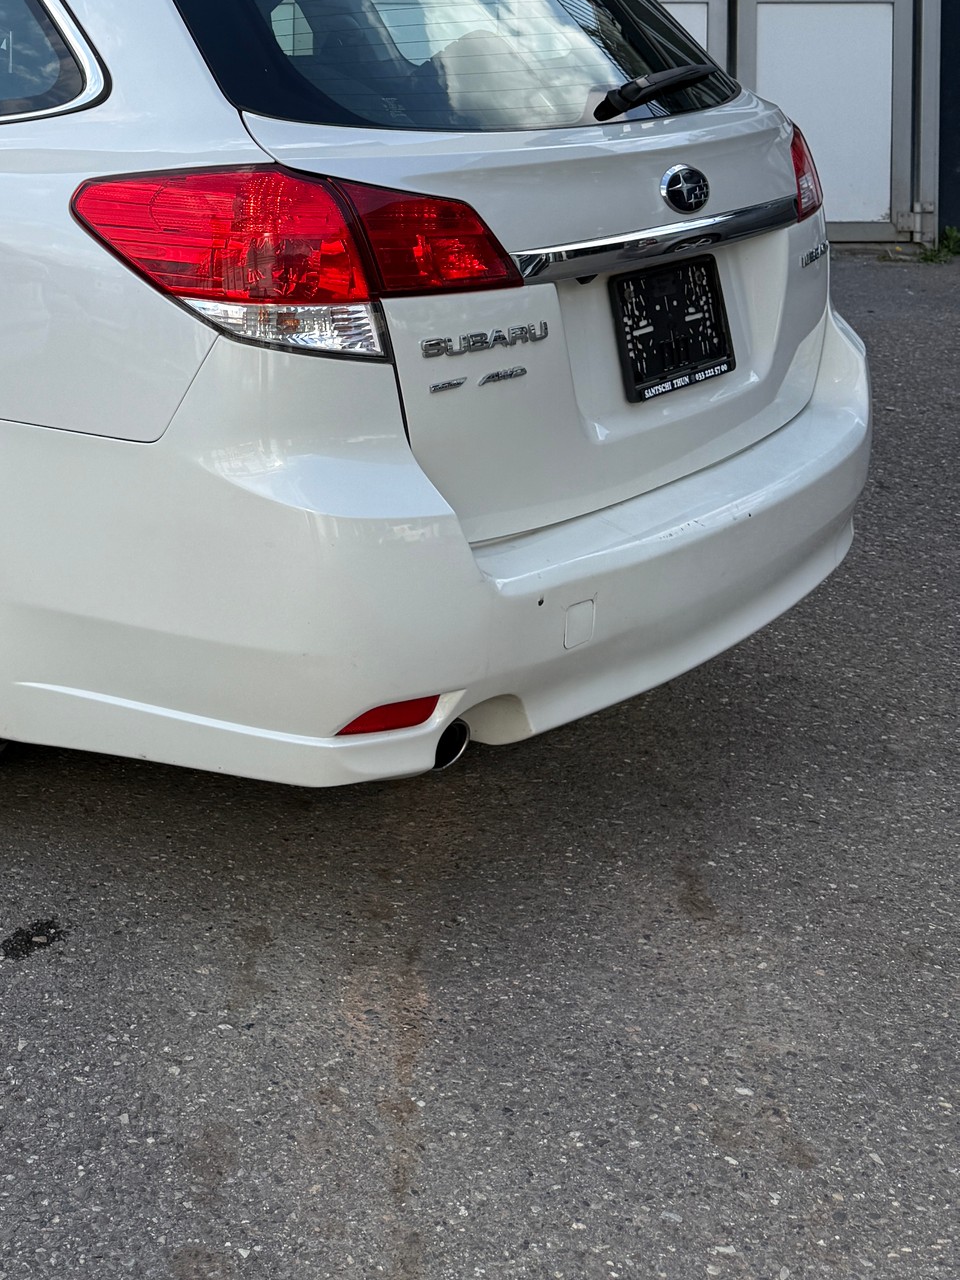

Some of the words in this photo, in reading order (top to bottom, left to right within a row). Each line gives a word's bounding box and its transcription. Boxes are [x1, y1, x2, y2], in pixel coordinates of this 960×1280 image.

[421, 320, 548, 358] SUBARU
[673, 375, 690, 388] THUN
[695, 372, 705, 381] 033
[705, 368, 715, 377] 222
[720, 363, 728, 372] 00
